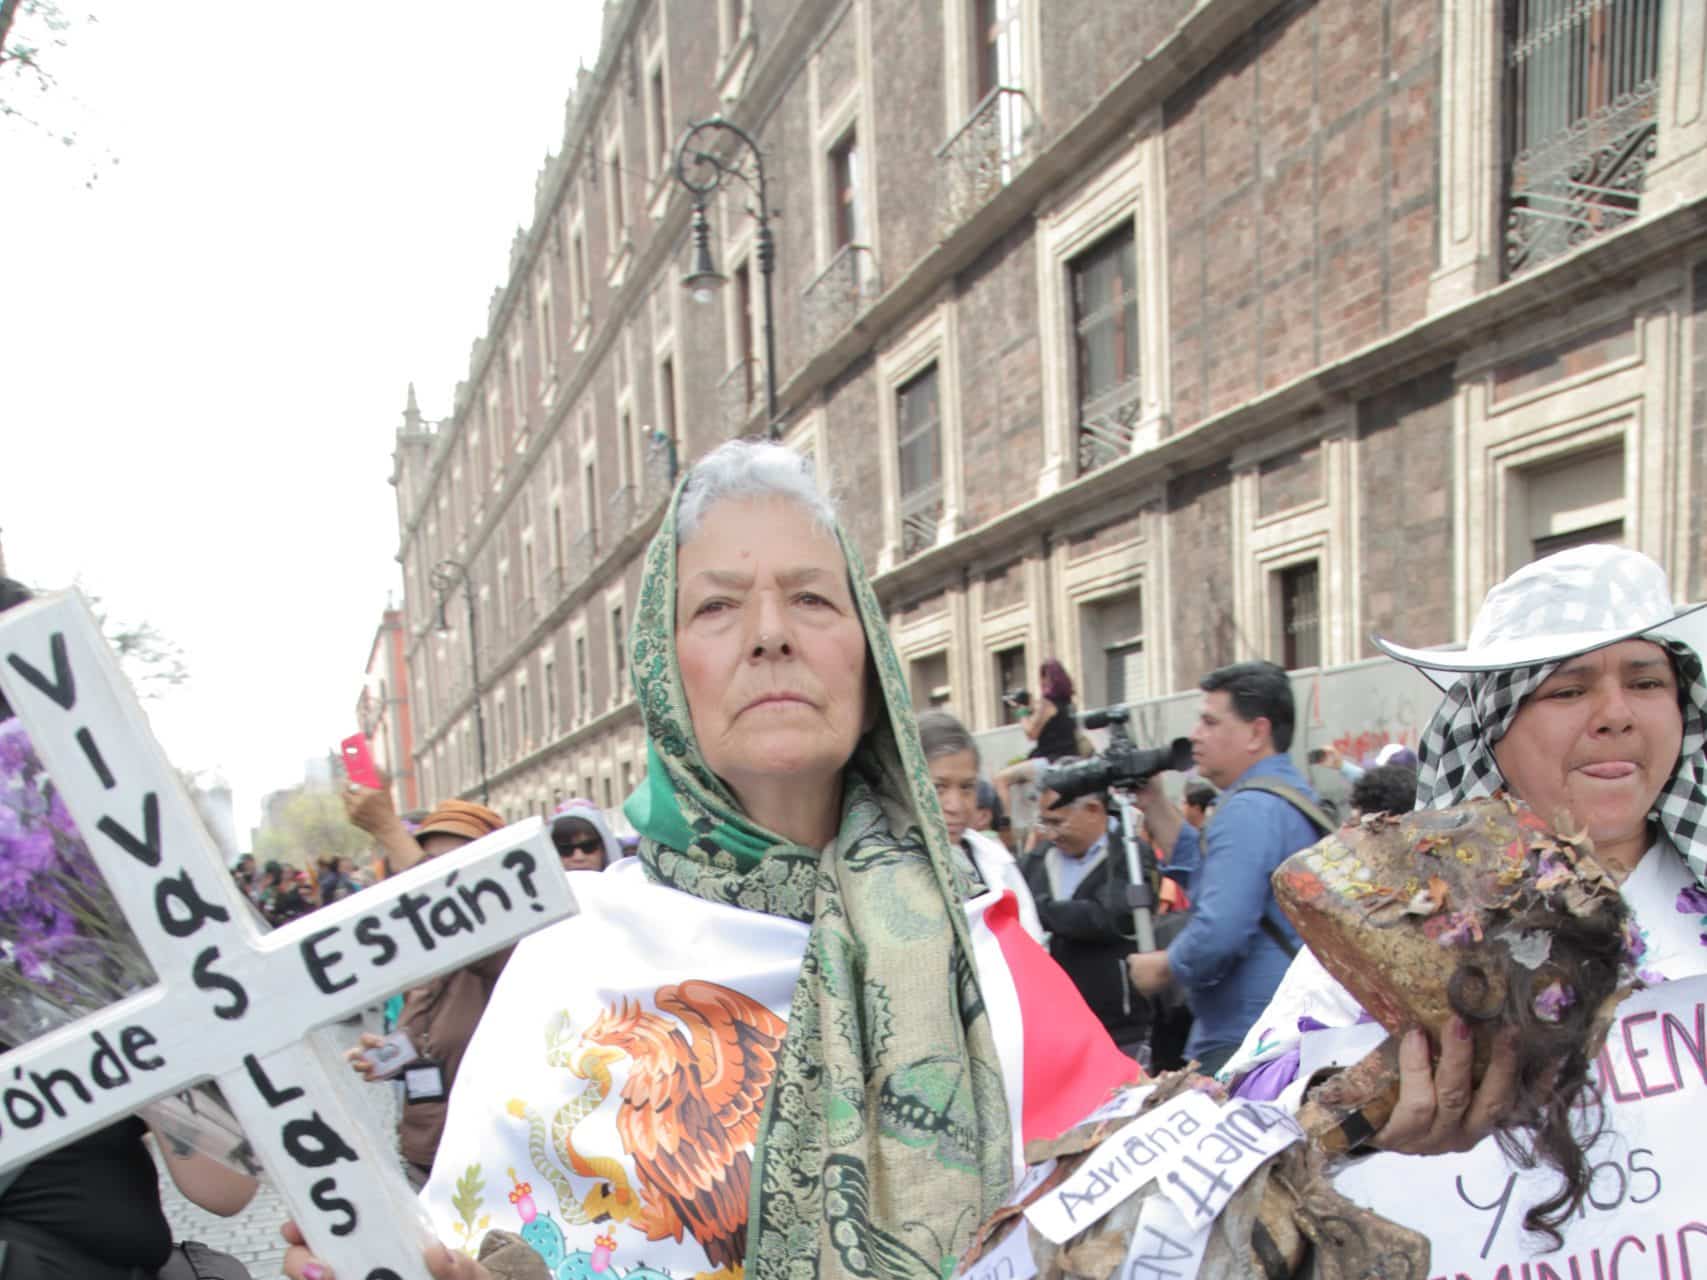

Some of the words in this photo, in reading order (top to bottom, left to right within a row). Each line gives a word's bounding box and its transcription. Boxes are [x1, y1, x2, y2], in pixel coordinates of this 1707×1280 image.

[0, 1024, 166, 1139] ónde
[300, 848, 545, 996] Están?
[1059, 1109, 1201, 1223] Adriana
